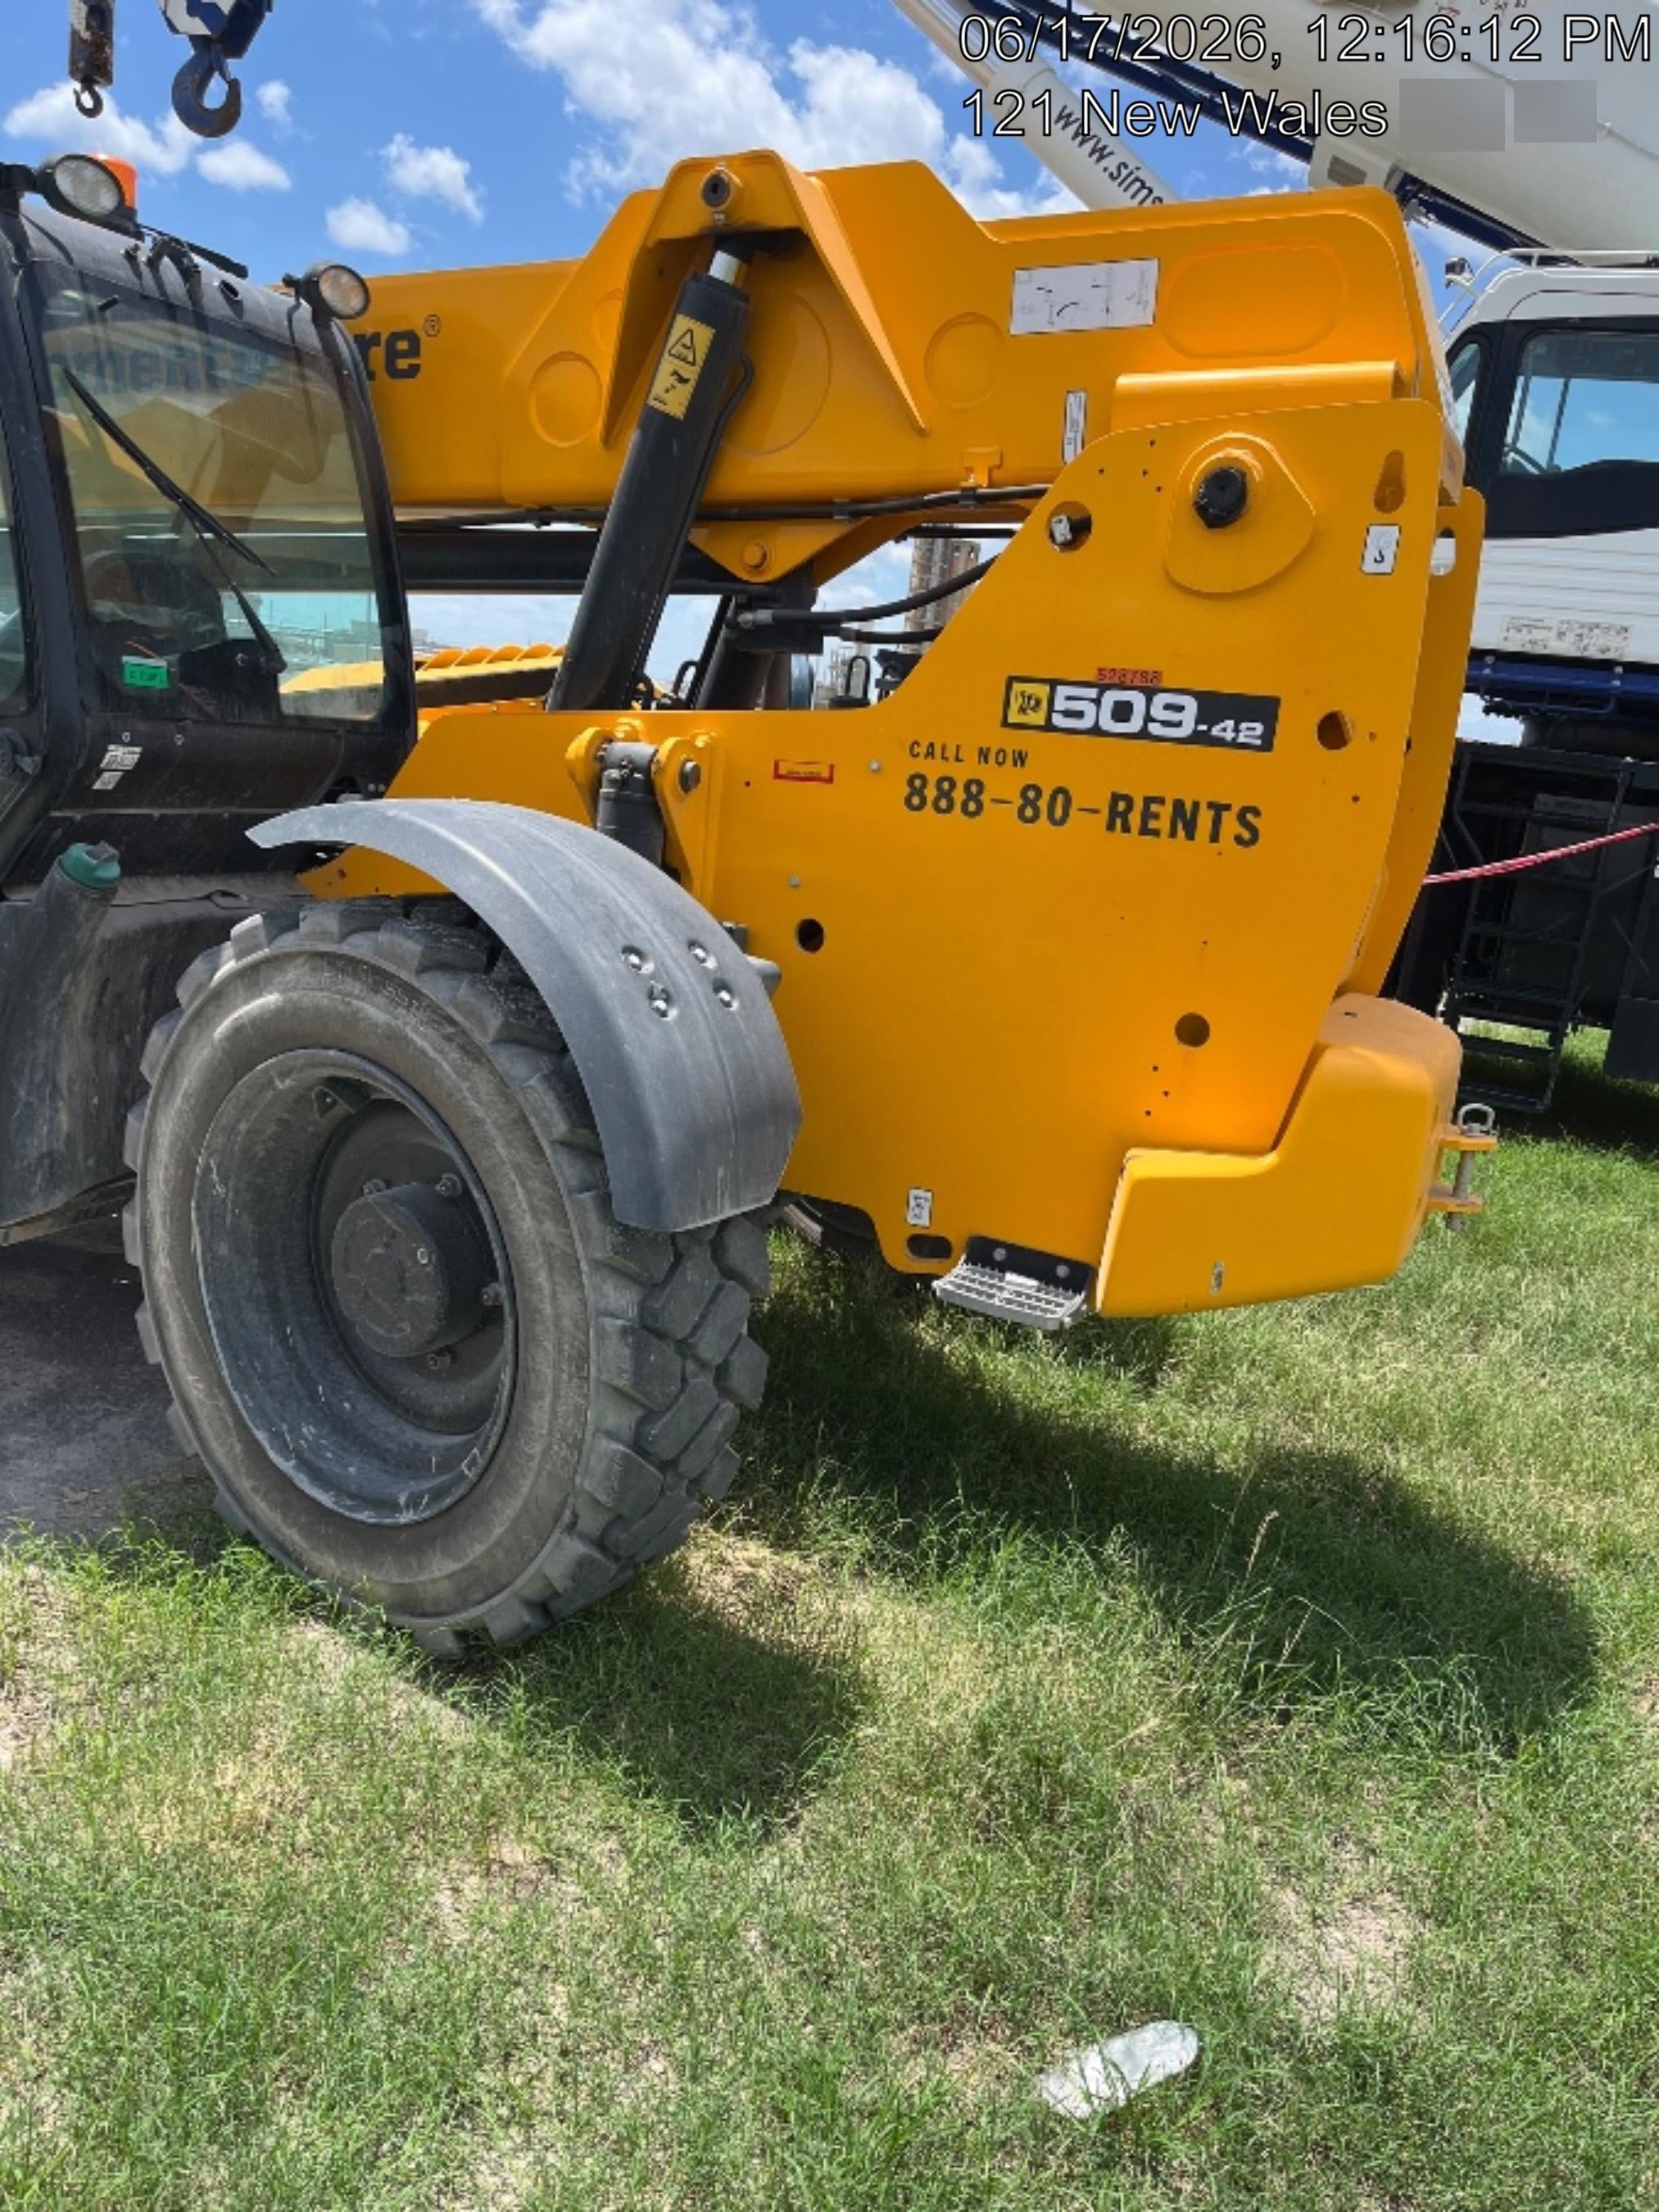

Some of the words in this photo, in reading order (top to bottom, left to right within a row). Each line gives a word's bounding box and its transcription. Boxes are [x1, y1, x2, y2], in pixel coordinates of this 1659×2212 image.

[1051, 685, 1264, 746] 509-42
[909, 741, 965, 764] CALL
[977, 746, 1029, 768] NOW
[903, 772, 1263, 849] 888-80-RENTS
